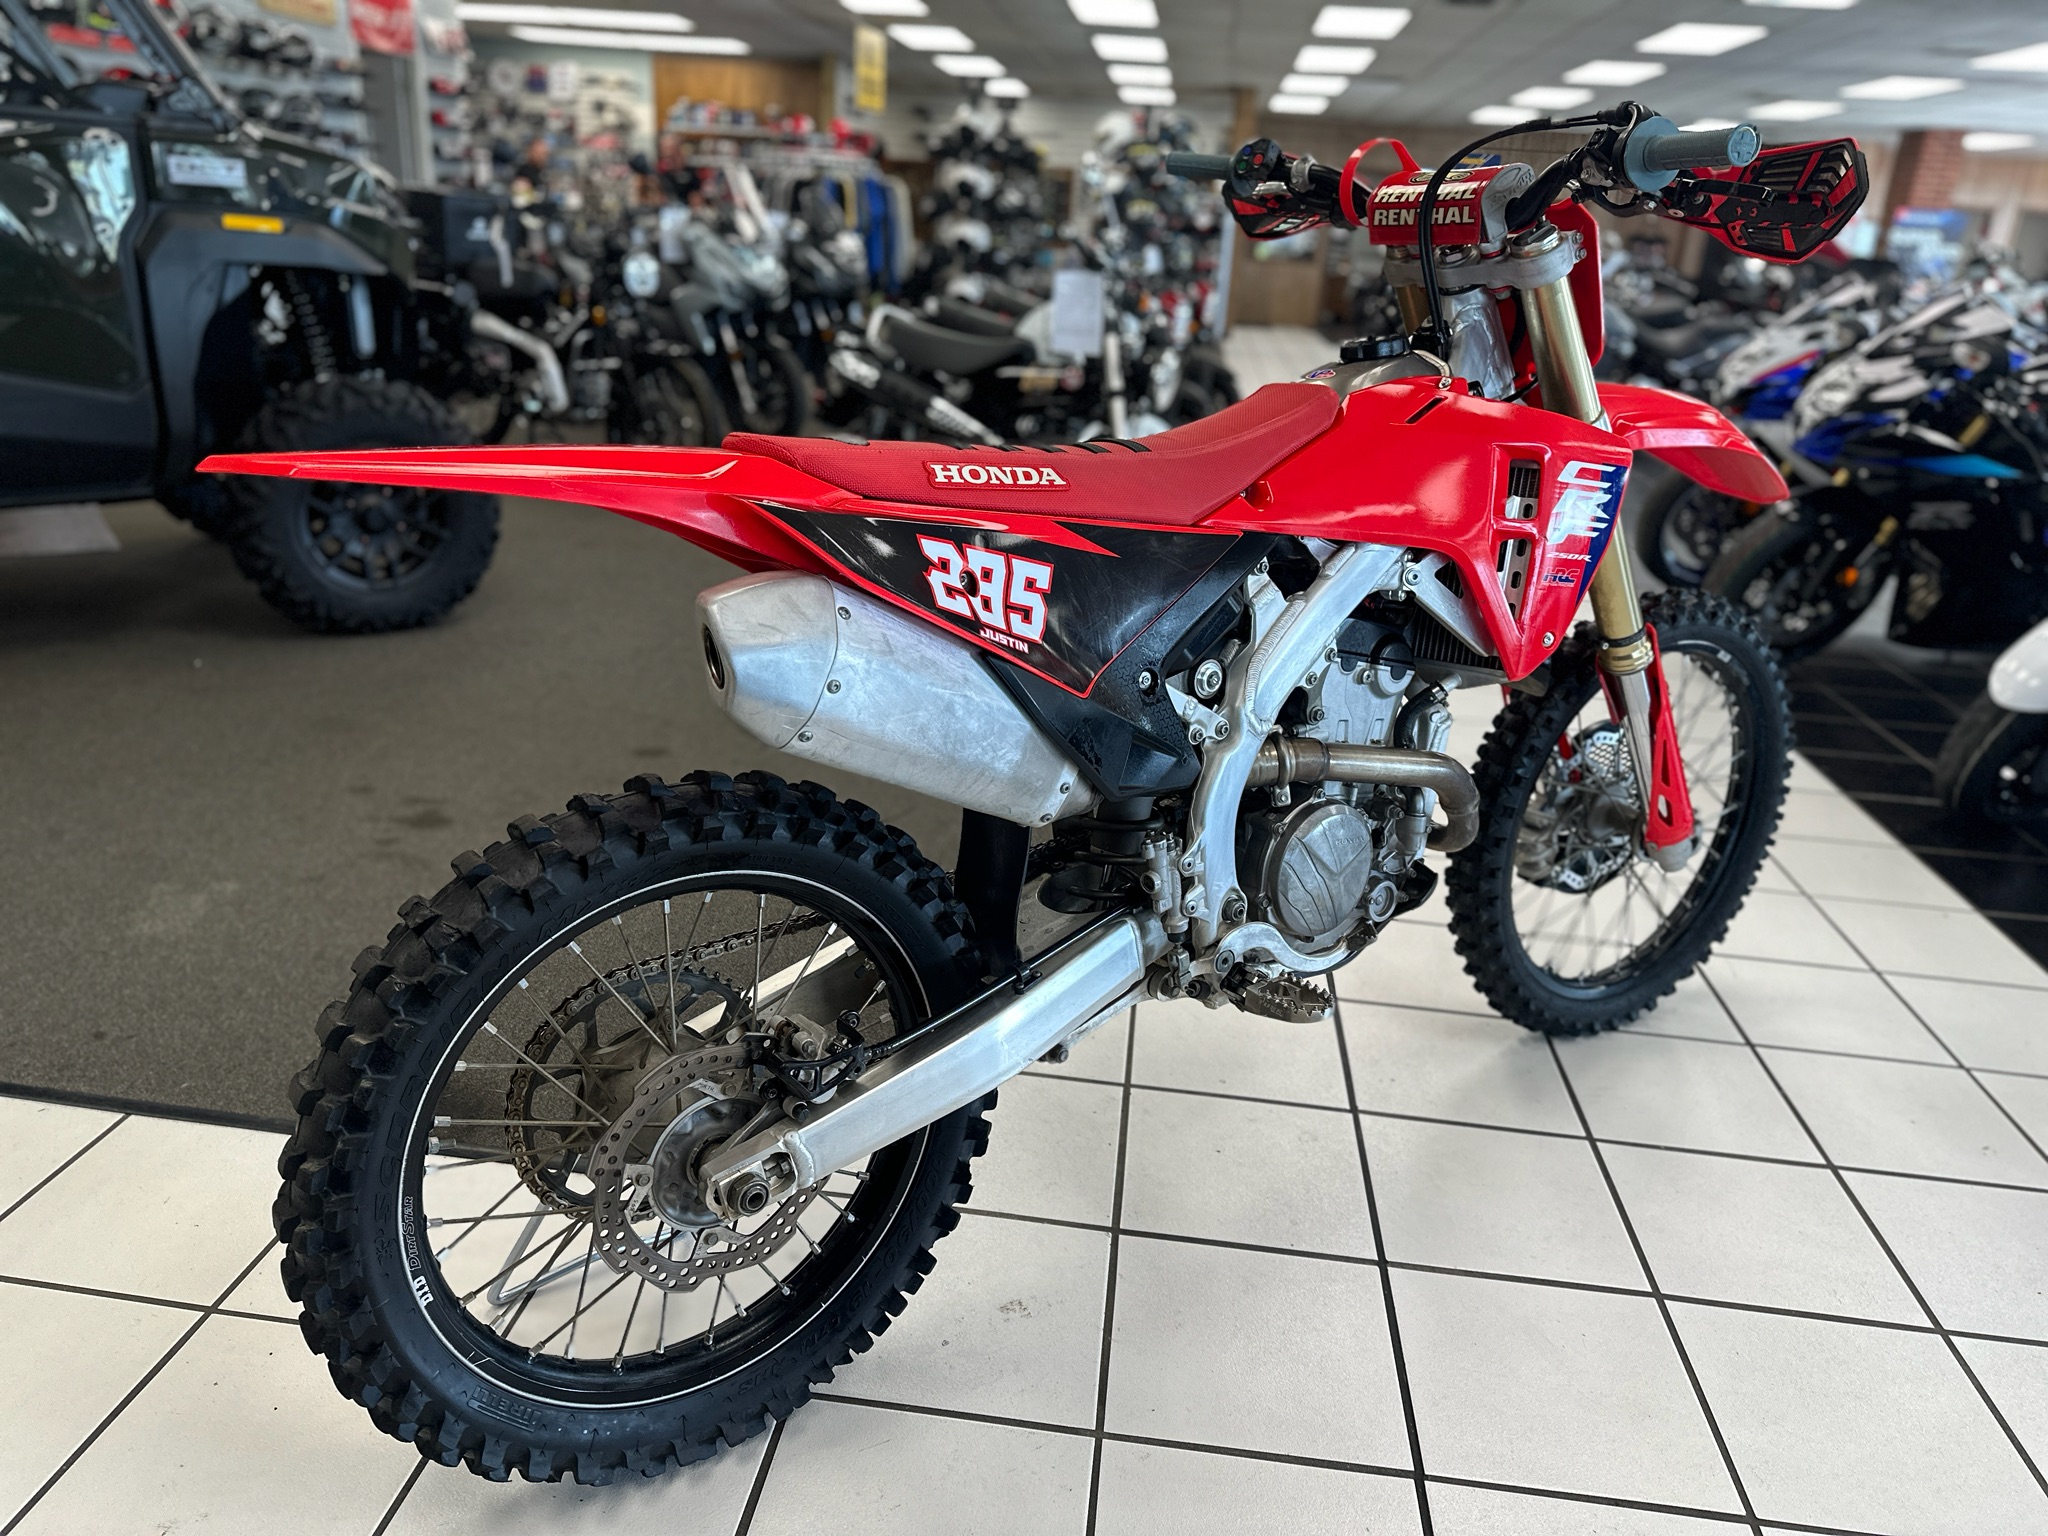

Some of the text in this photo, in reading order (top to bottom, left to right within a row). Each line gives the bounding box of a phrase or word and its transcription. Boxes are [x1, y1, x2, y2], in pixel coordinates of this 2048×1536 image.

[1373, 206, 1475, 226] RENHAL
[930, 464, 1067, 486] HONDA
[1546, 551, 1592, 562] 250R
[916, 534, 1054, 644] 285
[980, 627, 1029, 654] JUSTIN
